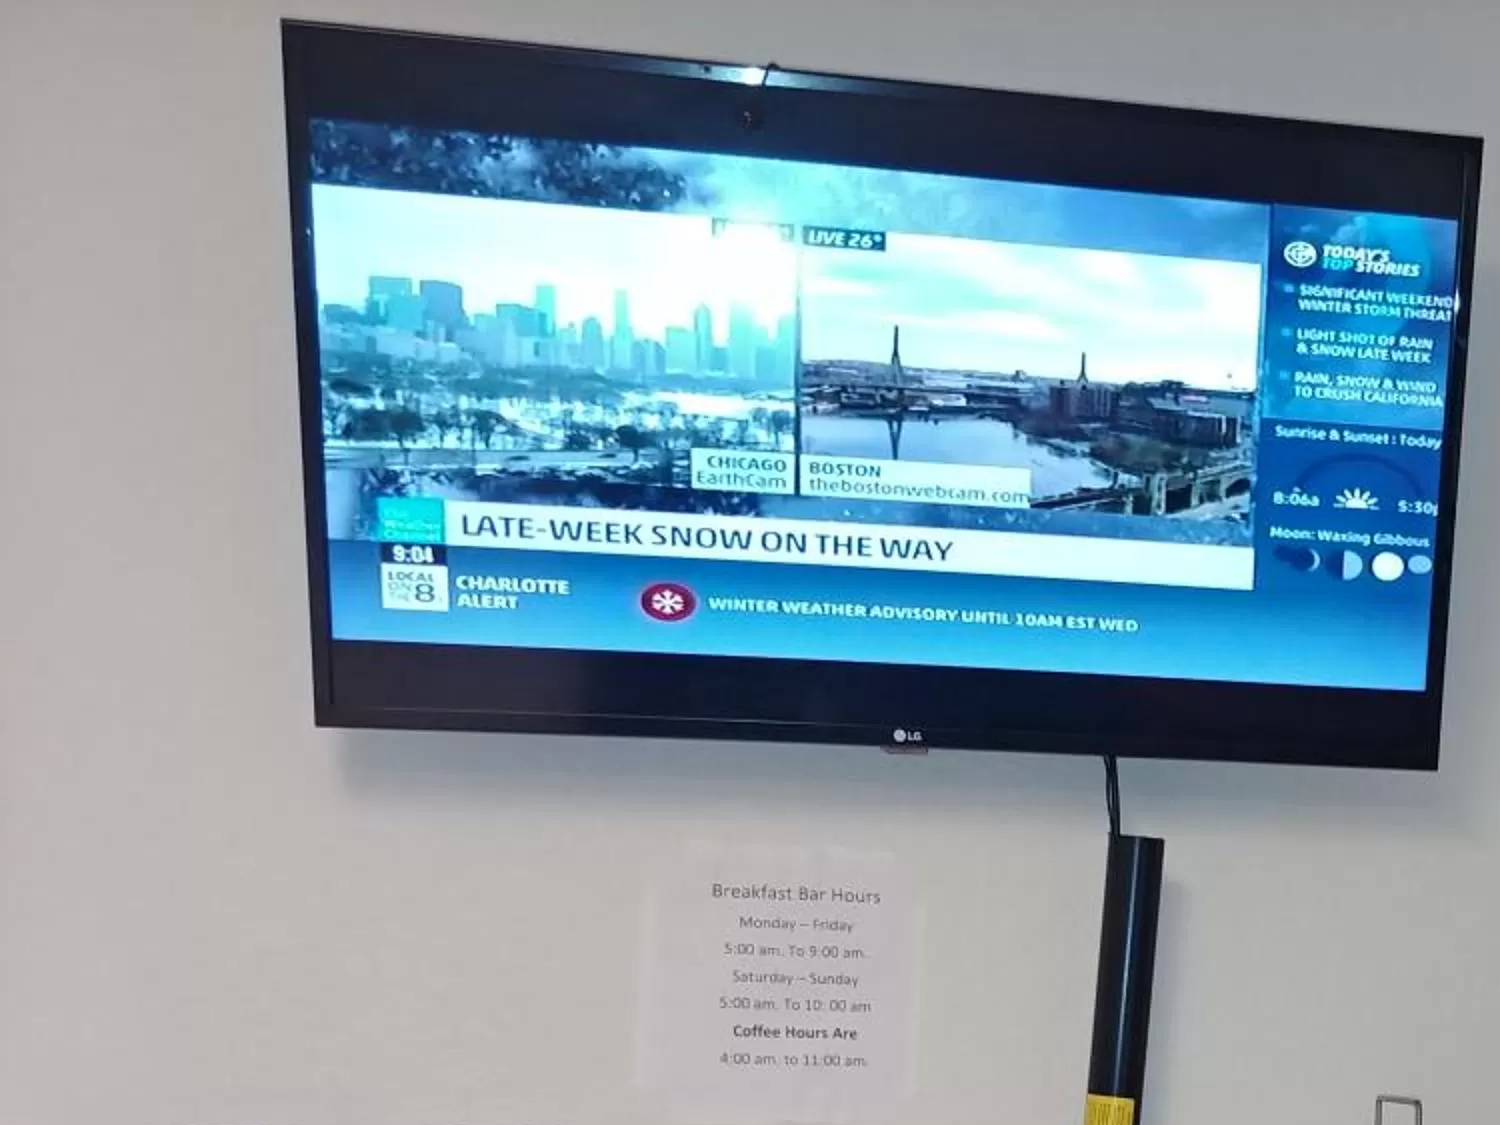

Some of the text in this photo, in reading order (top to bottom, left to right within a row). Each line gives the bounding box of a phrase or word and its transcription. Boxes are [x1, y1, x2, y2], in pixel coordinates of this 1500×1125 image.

[808, 229, 845, 246] LIVE
[848, 232, 883, 249] 26°
[1322, 244, 1391, 263] TODAY'S
[1322, 258, 1421, 277] TOP STORIES
[1300, 283, 1453, 307] SIGNIFICANT WEEKEND
[1298, 299, 1452, 323] WINTER STORM THREAT
[1296, 327, 1433, 350] LIGHT SHOT OF RAIN
[1296, 343, 1433, 364] & SNOW LATE WEEK
[1294, 371, 1437, 393] RAIN, SNOW & WIND
[1294, 385, 1443, 407] TO CRUSH CALIFORNIA
[1275, 425, 1327, 441] Sunrise
[1329, 429, 1340, 442] &
[1343, 430, 1389, 445] Sunset
[1400, 432, 1443, 450] Today
[706, 455, 787, 473] CHICAGO
[809, 461, 881, 478] BOSTON
[696, 469, 787, 489] EarthCam
[809, 476, 1031, 504] thebostonwebcam.com
[462, 513, 643, 546] LATE-WEEK
[651, 524, 752, 551] SNOW
[761, 531, 808, 554] ON
[815, 534, 871, 557] THE
[879, 538, 955, 562] WAY
[1270, 526, 1430, 548] Moon: Waxing Gibbous
[388, 571, 434, 583] LOCAL
[455, 575, 571, 595] CHARLOTTE
[415, 583, 436, 603] 8
[456, 594, 519, 609] ALERT
[708, 597, 1139, 633] WINTER WEATHER ADVISORY UNTIL 10AM EST WED
[711, 883, 882, 905] Breakfast Bar Hours
[738, 916, 797, 932] Monday
[812, 918, 853, 934] Friday
[723, 942, 754, 956] 5:00
[788, 944, 805, 958] To
[809, 945, 839, 959] 9:00
[732, 969, 794, 987] Saturday
[809, 972, 859, 988] Sunday
[718, 996, 750, 1009] 5:00
[784, 998, 801, 1011] To
[733, 1024, 858, 1041] Coffee Hours Are
[719, 1052, 751, 1066] 4:00
[784, 1053, 798, 1067] to
[803, 1054, 841, 1067] 11:00
